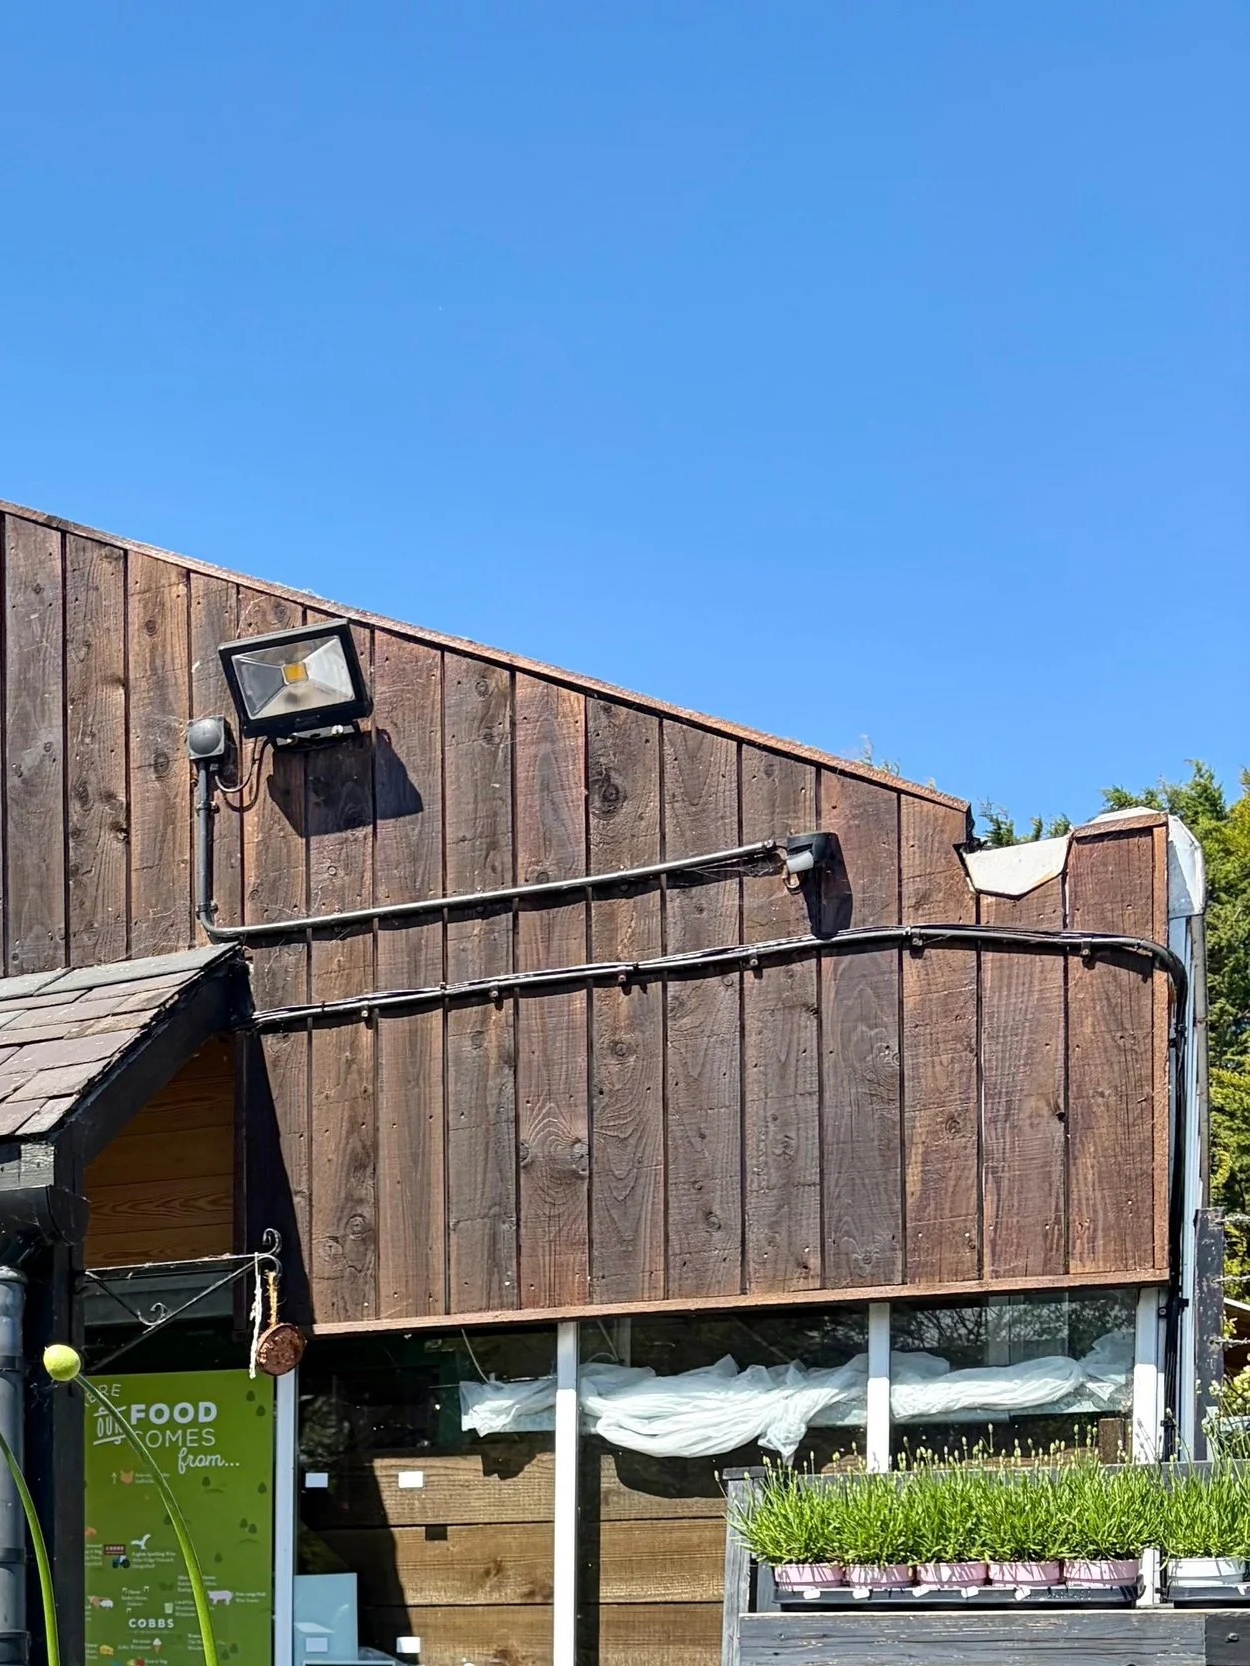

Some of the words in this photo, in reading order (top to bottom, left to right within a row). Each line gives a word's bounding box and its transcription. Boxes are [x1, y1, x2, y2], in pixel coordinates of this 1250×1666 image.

[130, 1401, 218, 1425] FOOD
[177, 1447, 240, 1474] from...
[128, 1618, 175, 1629] COBBS
